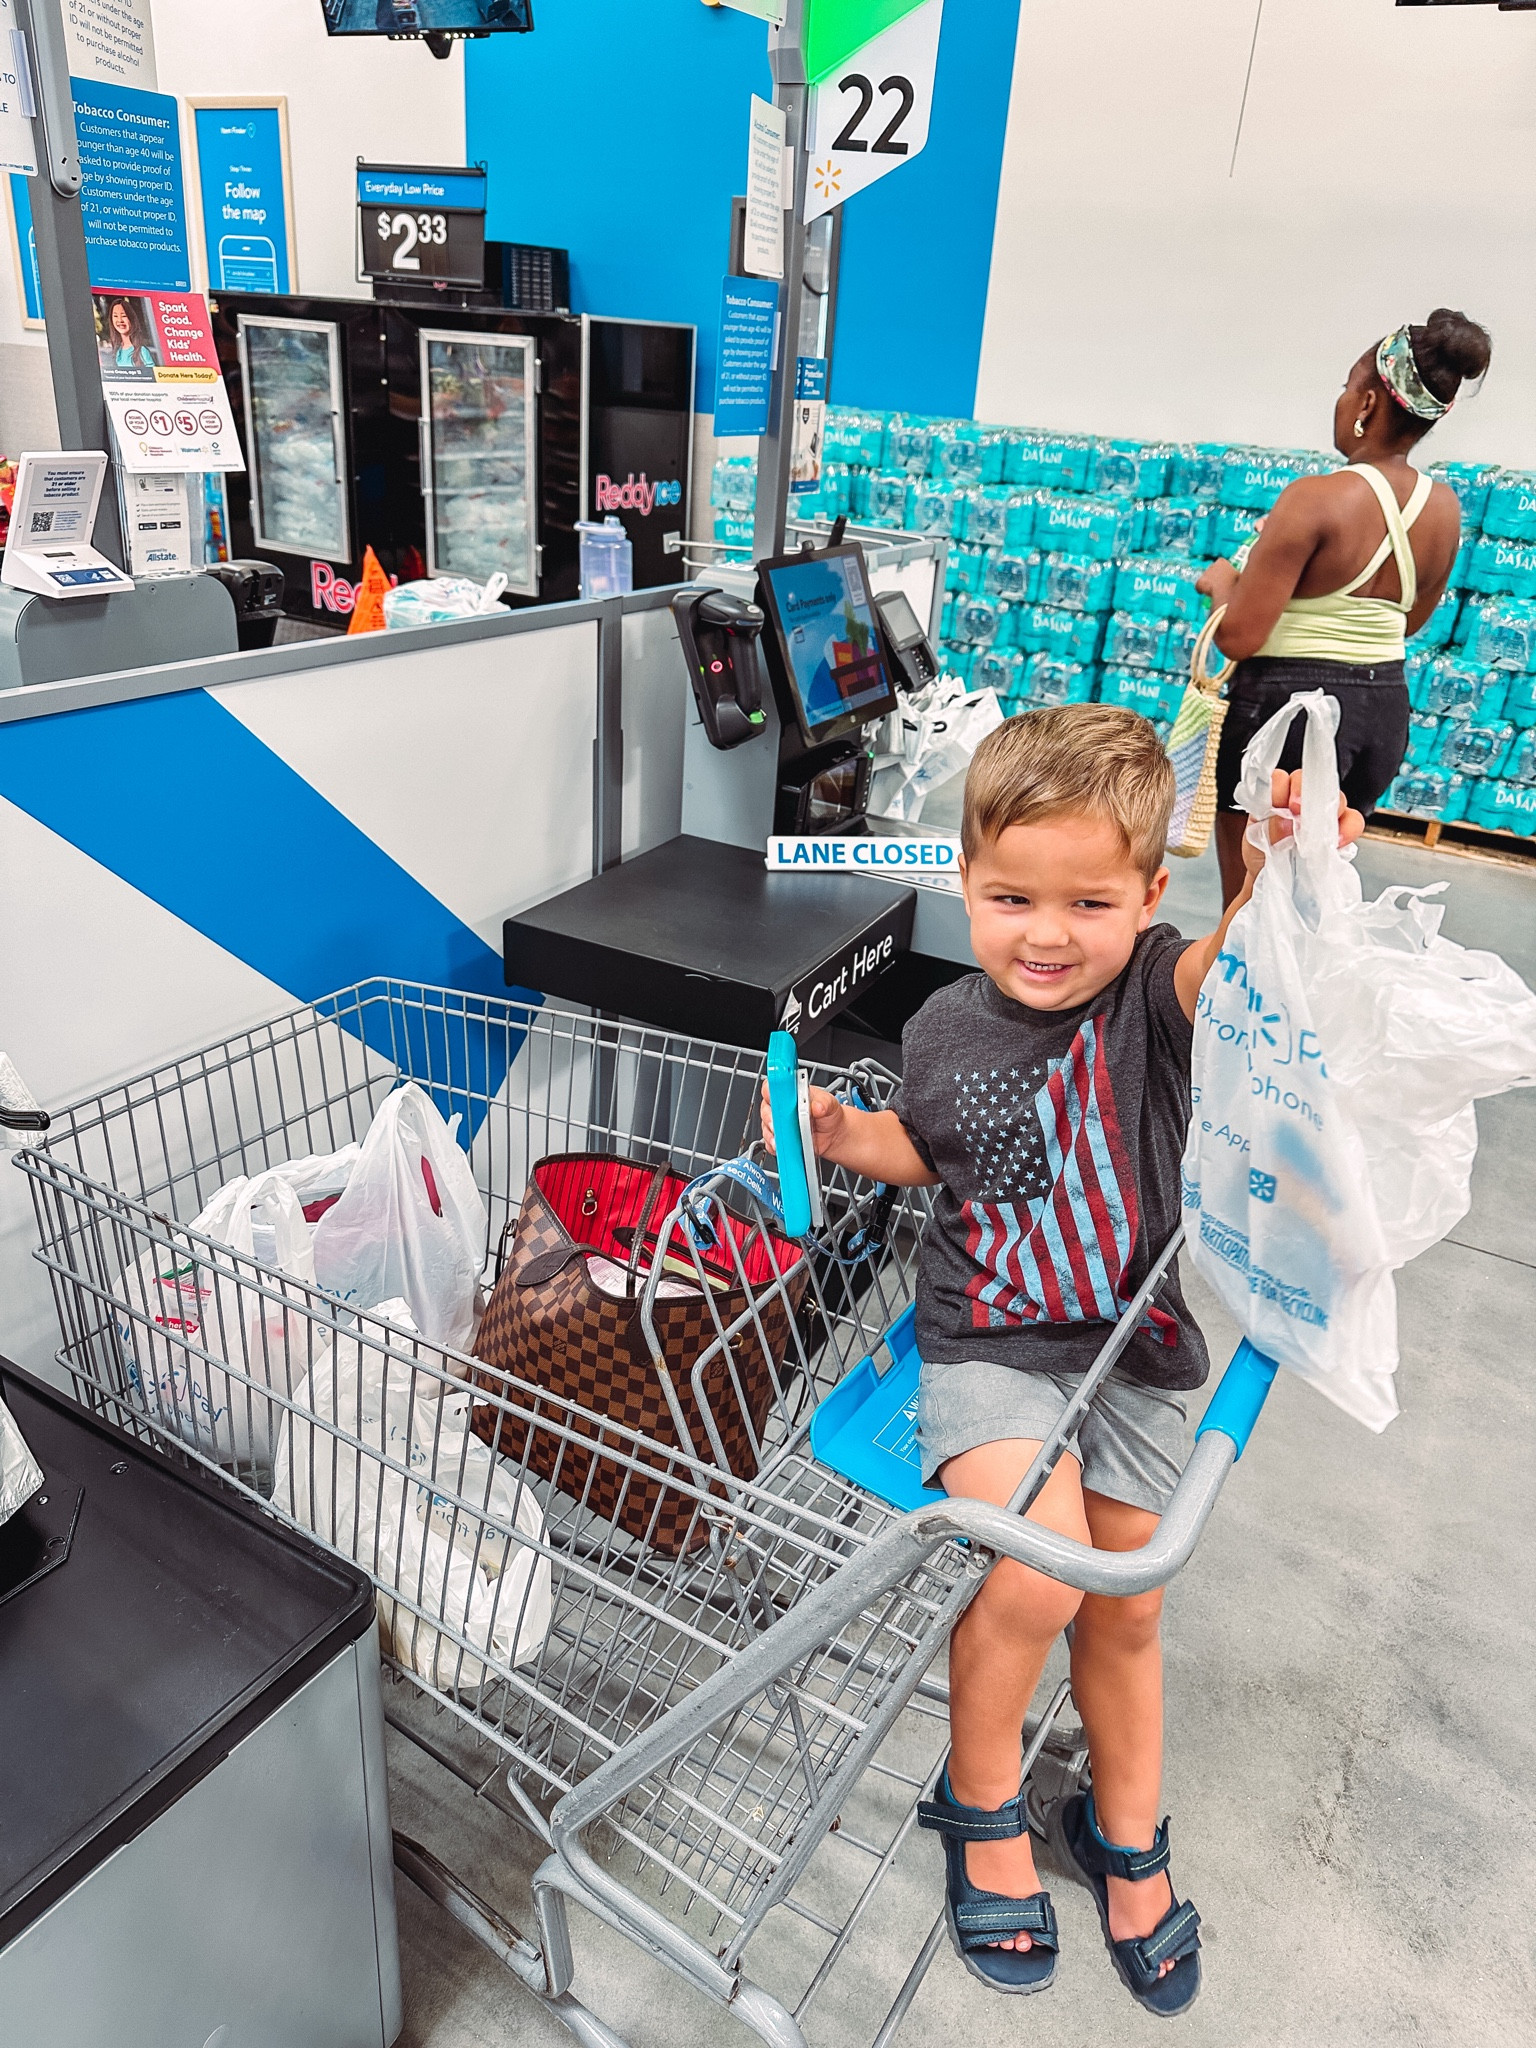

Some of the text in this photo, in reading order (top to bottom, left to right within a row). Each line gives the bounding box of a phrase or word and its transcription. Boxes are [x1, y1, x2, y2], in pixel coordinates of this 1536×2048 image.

[69, 0, 78, 10] of
[79, 2, 86, 14] 21
[88, 8, 95, 18] or
[96, 13, 121, 31] without
[122, 25, 142, 40] proper
[102, 1, 121, 15] under
[121, 10, 132, 22] the
[133, 18, 144, 28] age
[70, 13, 144, 56] ID will not be permitted
[76, 32, 140, 67] to purchase alcohol
[96, 56, 126, 74] products.
[2, 73, 16, 85] TO
[72, 100, 170, 129] Tobacco Consumer:
[831, 73, 915, 155] 22
[80, 122, 164, 146] Customers that appear
[77, 140, 174, 162] ounger than age 40 will be
[79, 155, 171, 176] asked to provide proof of
[94, 172, 105, 184] by
[106, 174, 138, 188] showing
[139, 180, 163, 192] proper
[225, 181, 260, 199] Follow
[365, 180, 444, 196] Everyday Low Price
[81, 186, 174, 208] Customers under the age
[80, 202, 89, 212] of
[103, 206, 112, 214] or
[112, 206, 142, 218] without
[142, 211, 167, 222] proper
[222, 203, 266, 225] the map
[88, 220, 174, 237] will not be permitted to
[118, 238, 148, 250] tobacco
[150, 242, 182, 253] products.
[158, 302, 188, 314] Spark
[726, 295, 773, 309] Tobacco Consumer:
[161, 314, 192, 326] Good.
[164, 326, 204, 340] Change
[166, 339, 190, 350] Kids'
[170, 350, 206, 362] Health.
[194, 372, 214, 380] Today!
[154, 415, 168, 431] $1
[178, 416, 193, 431] $5
[1022, 448, 1062, 464] DASANI
[1244, 472, 1290, 488] DASANI
[1048, 510, 1092, 528] DASANI
[147, 552, 176, 562] Allstate
[1495, 548, 1536, 571] DASAN
[1134, 577, 1177, 595] DASANI
[786, 600, 800, 612] Card
[1032, 616, 1073, 633] DASANI
[1119, 680, 1161, 698] DASANI
[778, 842, 954, 866] LANE CLOSED
[808, 934, 893, 1018] Cart Here
[726, 1166, 746, 1180] seat
[742, 1160, 766, 1185] Always
